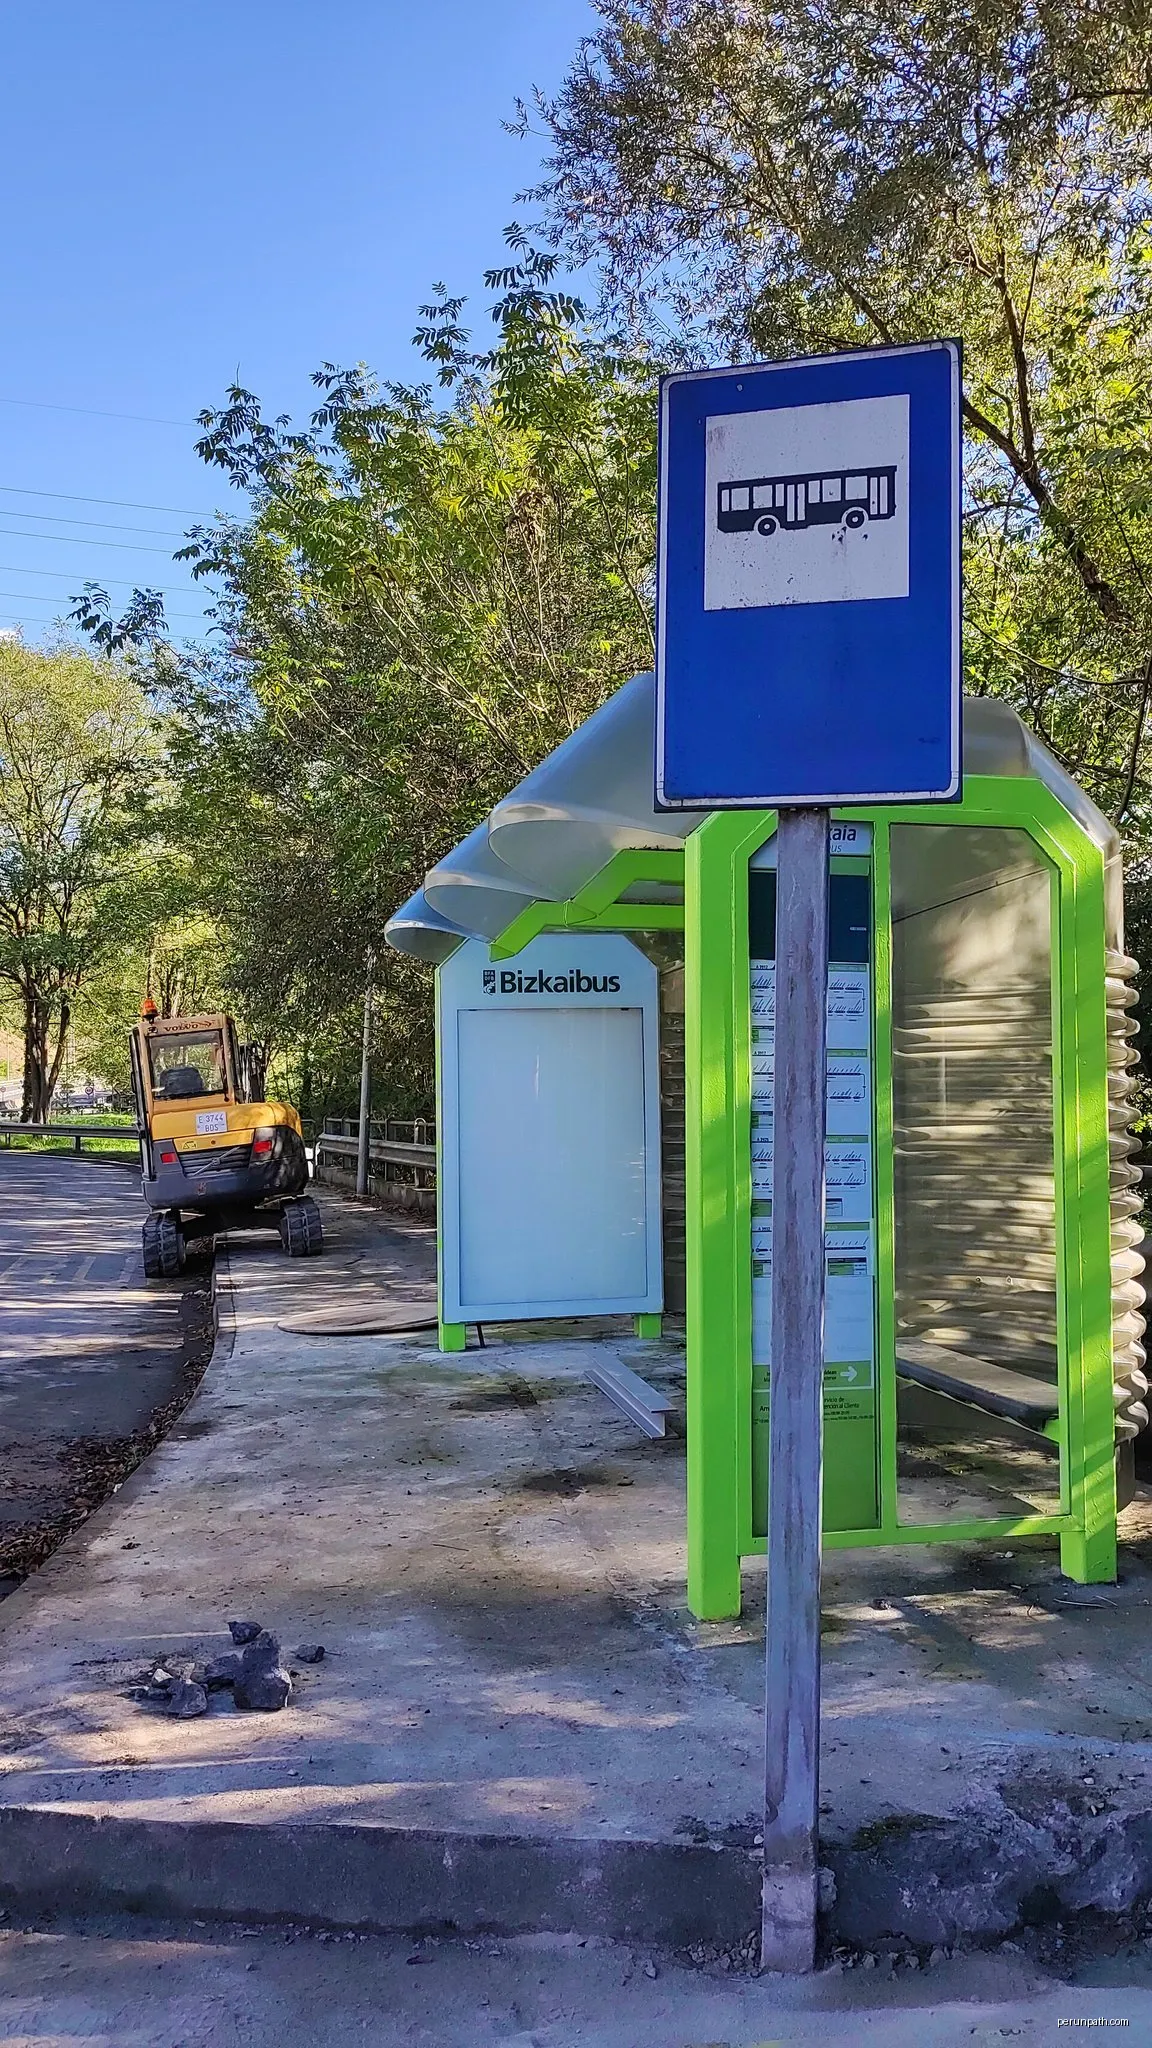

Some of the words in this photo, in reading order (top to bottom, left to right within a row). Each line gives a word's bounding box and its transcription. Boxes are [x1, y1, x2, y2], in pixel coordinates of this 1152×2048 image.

[830, 845, 842, 853] us
[500, 969, 621, 993] Bizkaibus
[164, 1022, 199, 1032] VOLVO
[198, 1115, 204, 1124] E
[205, 1113, 224, 1123] 3744
